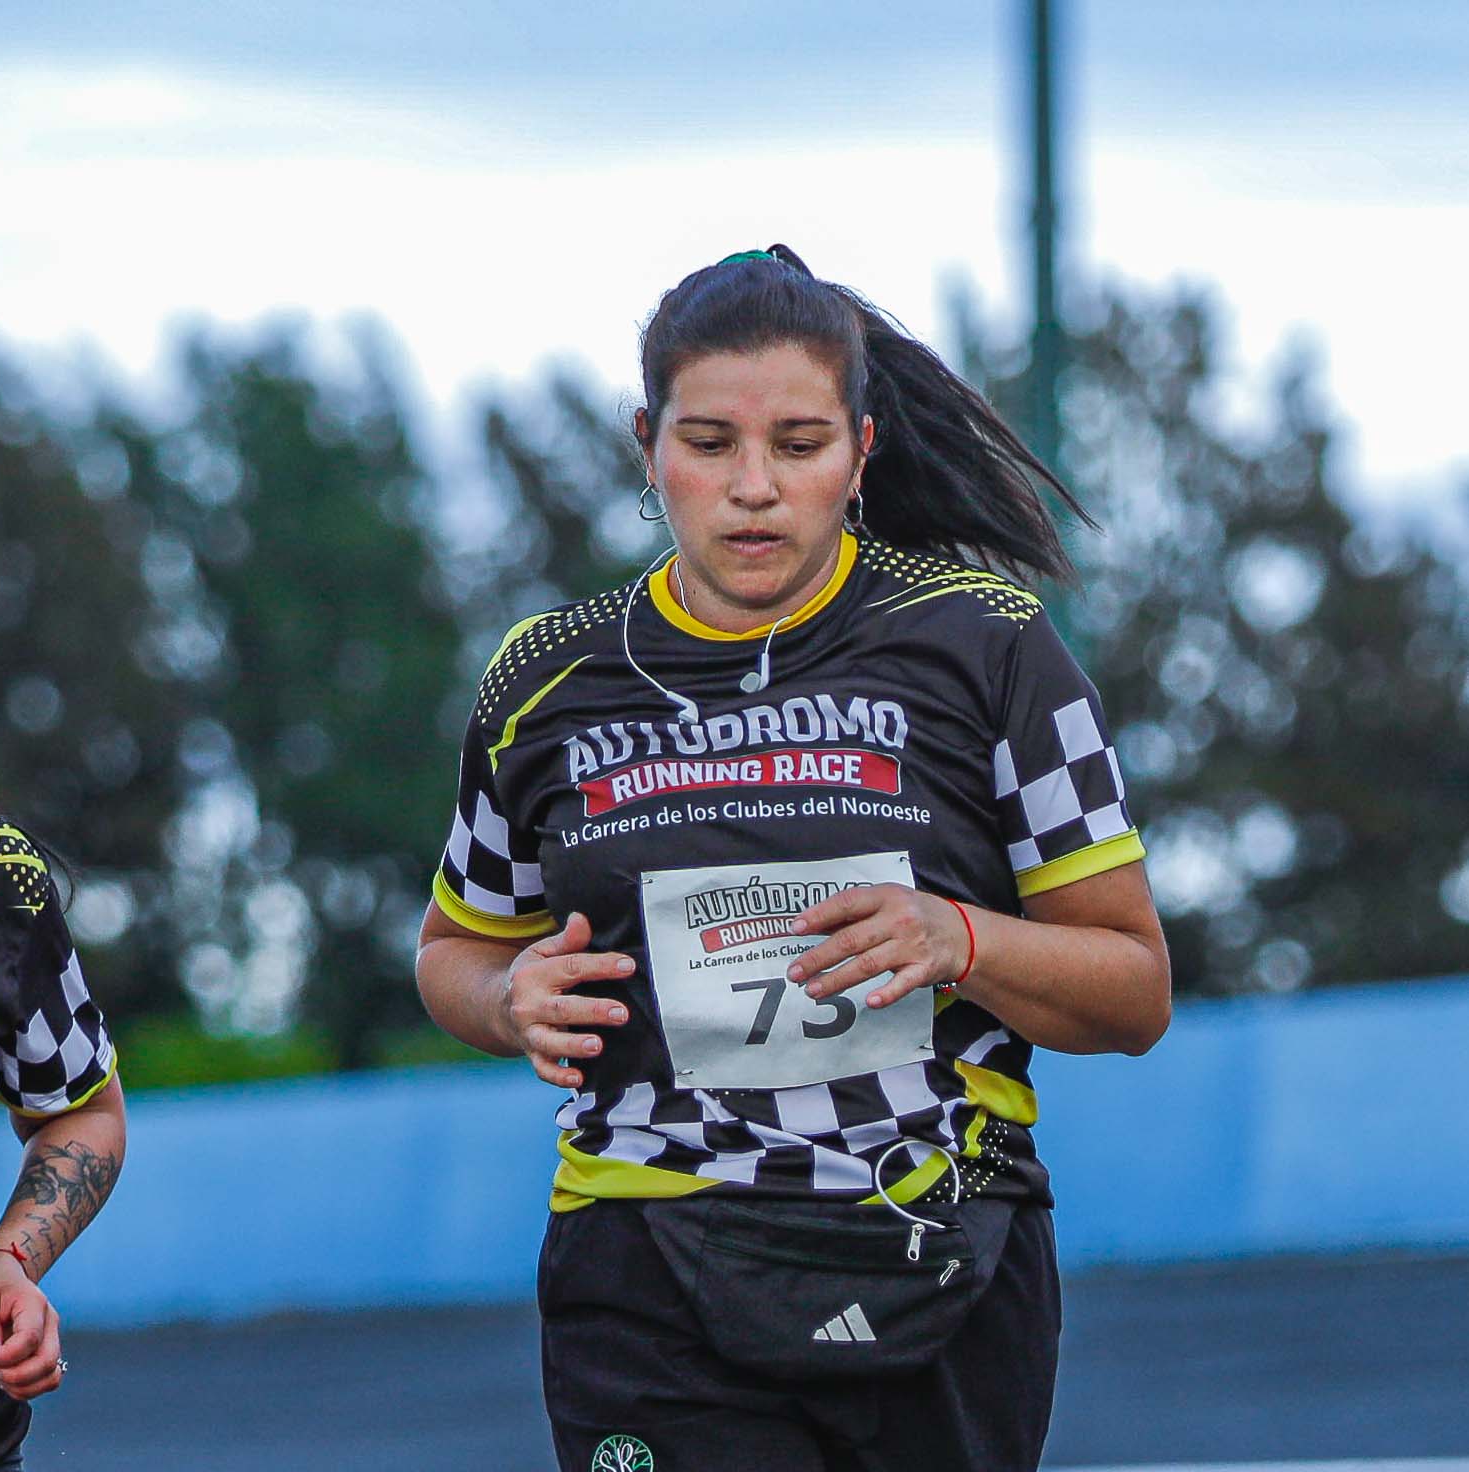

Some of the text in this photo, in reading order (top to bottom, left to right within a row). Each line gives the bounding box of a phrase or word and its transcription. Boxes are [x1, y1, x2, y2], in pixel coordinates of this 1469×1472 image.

[611, 754, 862, 803] RUNNING RACE
[562, 796, 931, 848] La Carrera de los Clubes del Noroeste
[683, 876, 874, 929] AUTÓDRO
[689, 943, 816, 970] La Carrera de los Clube
